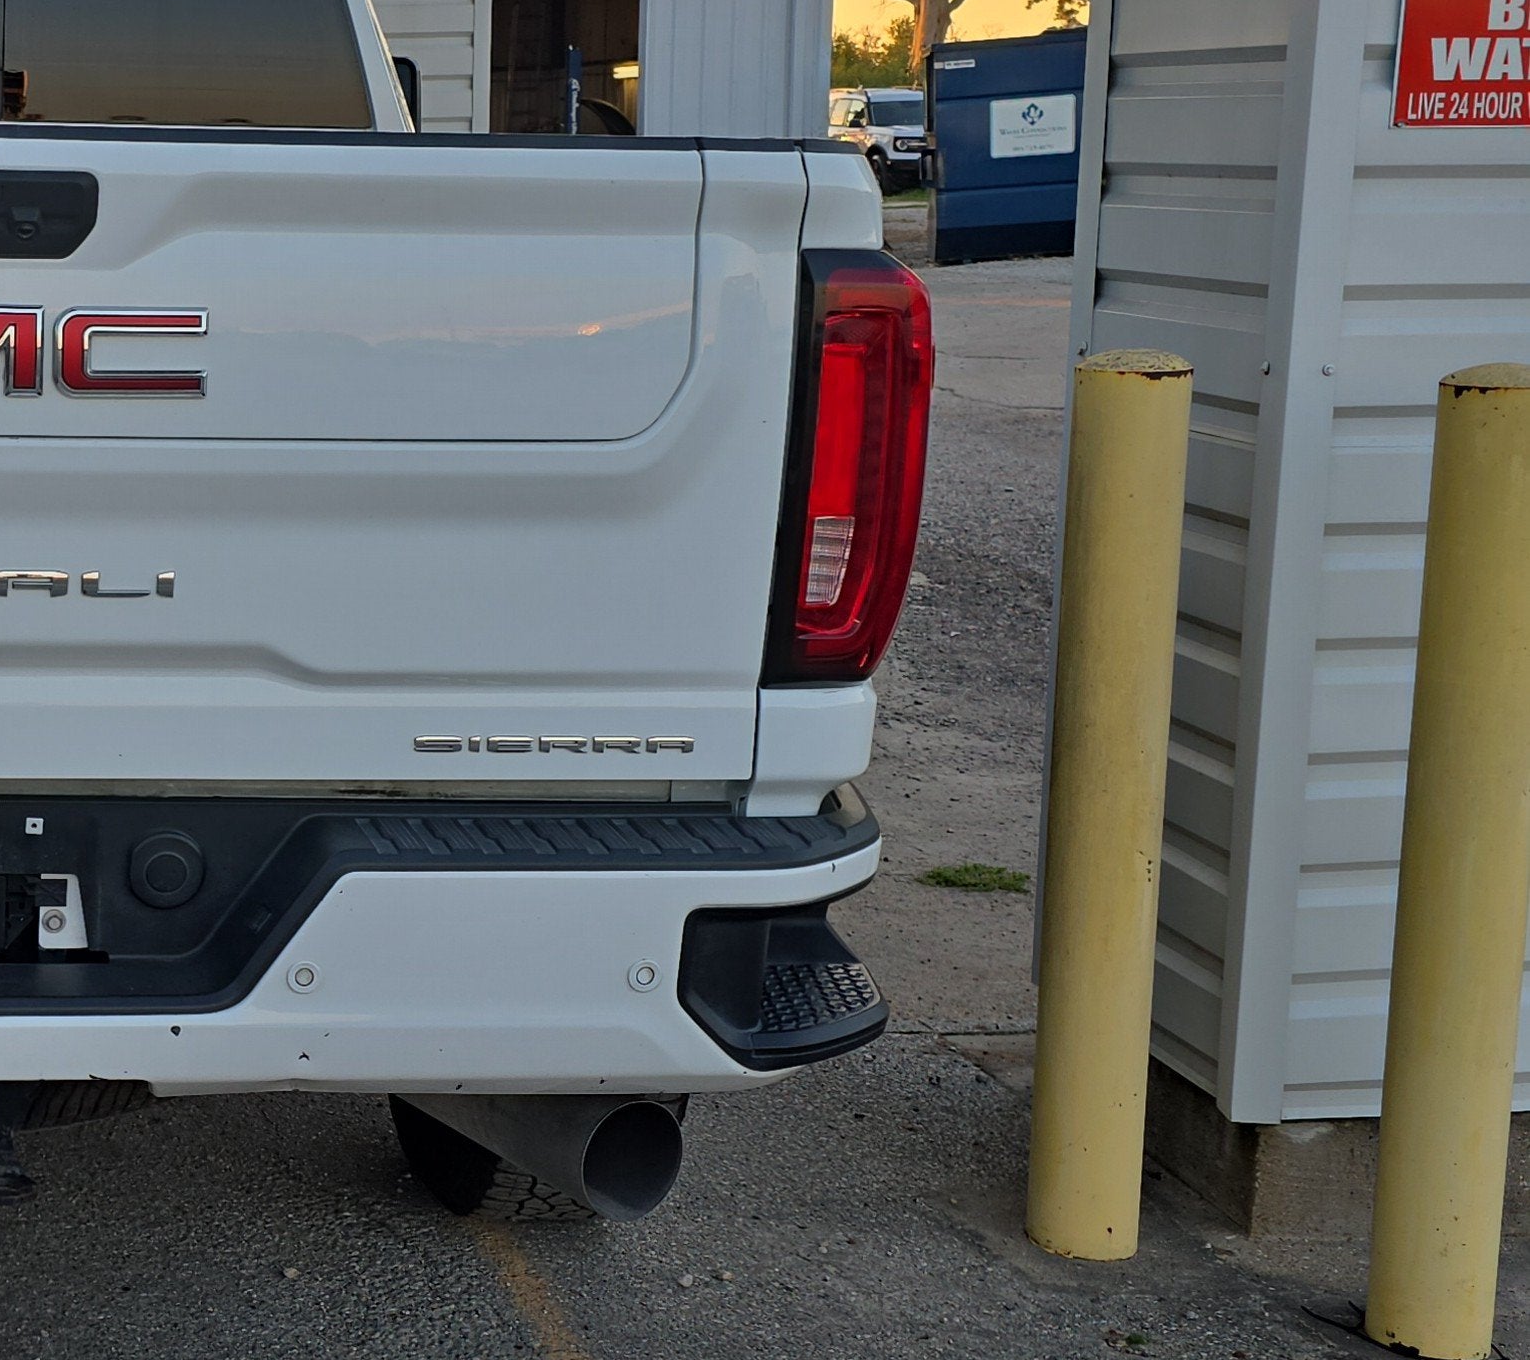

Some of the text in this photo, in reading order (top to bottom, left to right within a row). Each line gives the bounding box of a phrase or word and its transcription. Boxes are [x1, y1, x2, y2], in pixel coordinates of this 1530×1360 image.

[1431, 37, 1530, 81] WA
[1407, 92, 1446, 120] LIVE
[1448, 92, 1469, 119] 24
[1473, 91, 1523, 119] HOUR
[413, 735, 696, 754] SIERRA
